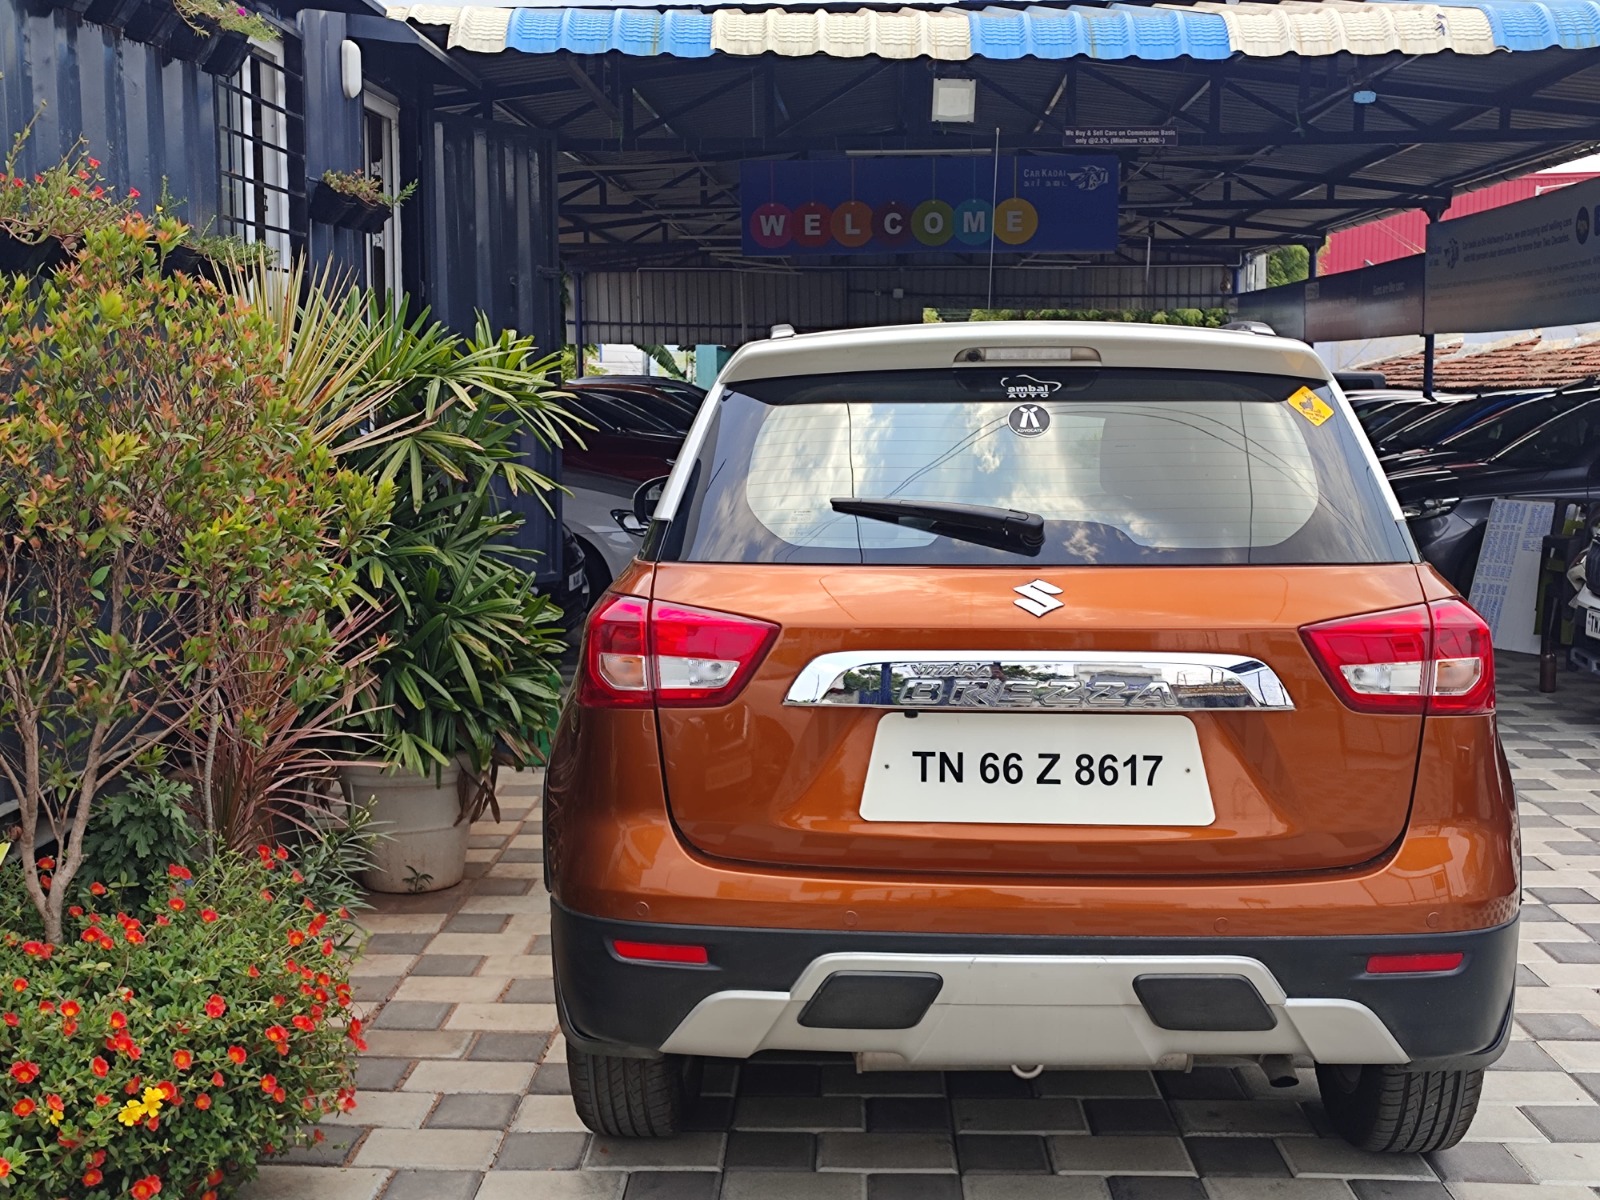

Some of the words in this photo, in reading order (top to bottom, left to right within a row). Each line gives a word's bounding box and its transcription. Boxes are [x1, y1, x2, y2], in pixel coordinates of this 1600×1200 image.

[1075, 129, 1086, 137] Buy
[1075, 137, 1087, 145] only
[760, 211, 1023, 235] WELCOME
[1008, 384, 1048, 392] ambal
[911, 663, 993, 678] VITARA
[900, 678, 1179, 707] BREZZA
[912, 751, 964, 783] TN
[980, 752, 1023, 784] 66
[1037, 753, 1061, 785] Z
[1075, 754, 1163, 787] 8617
